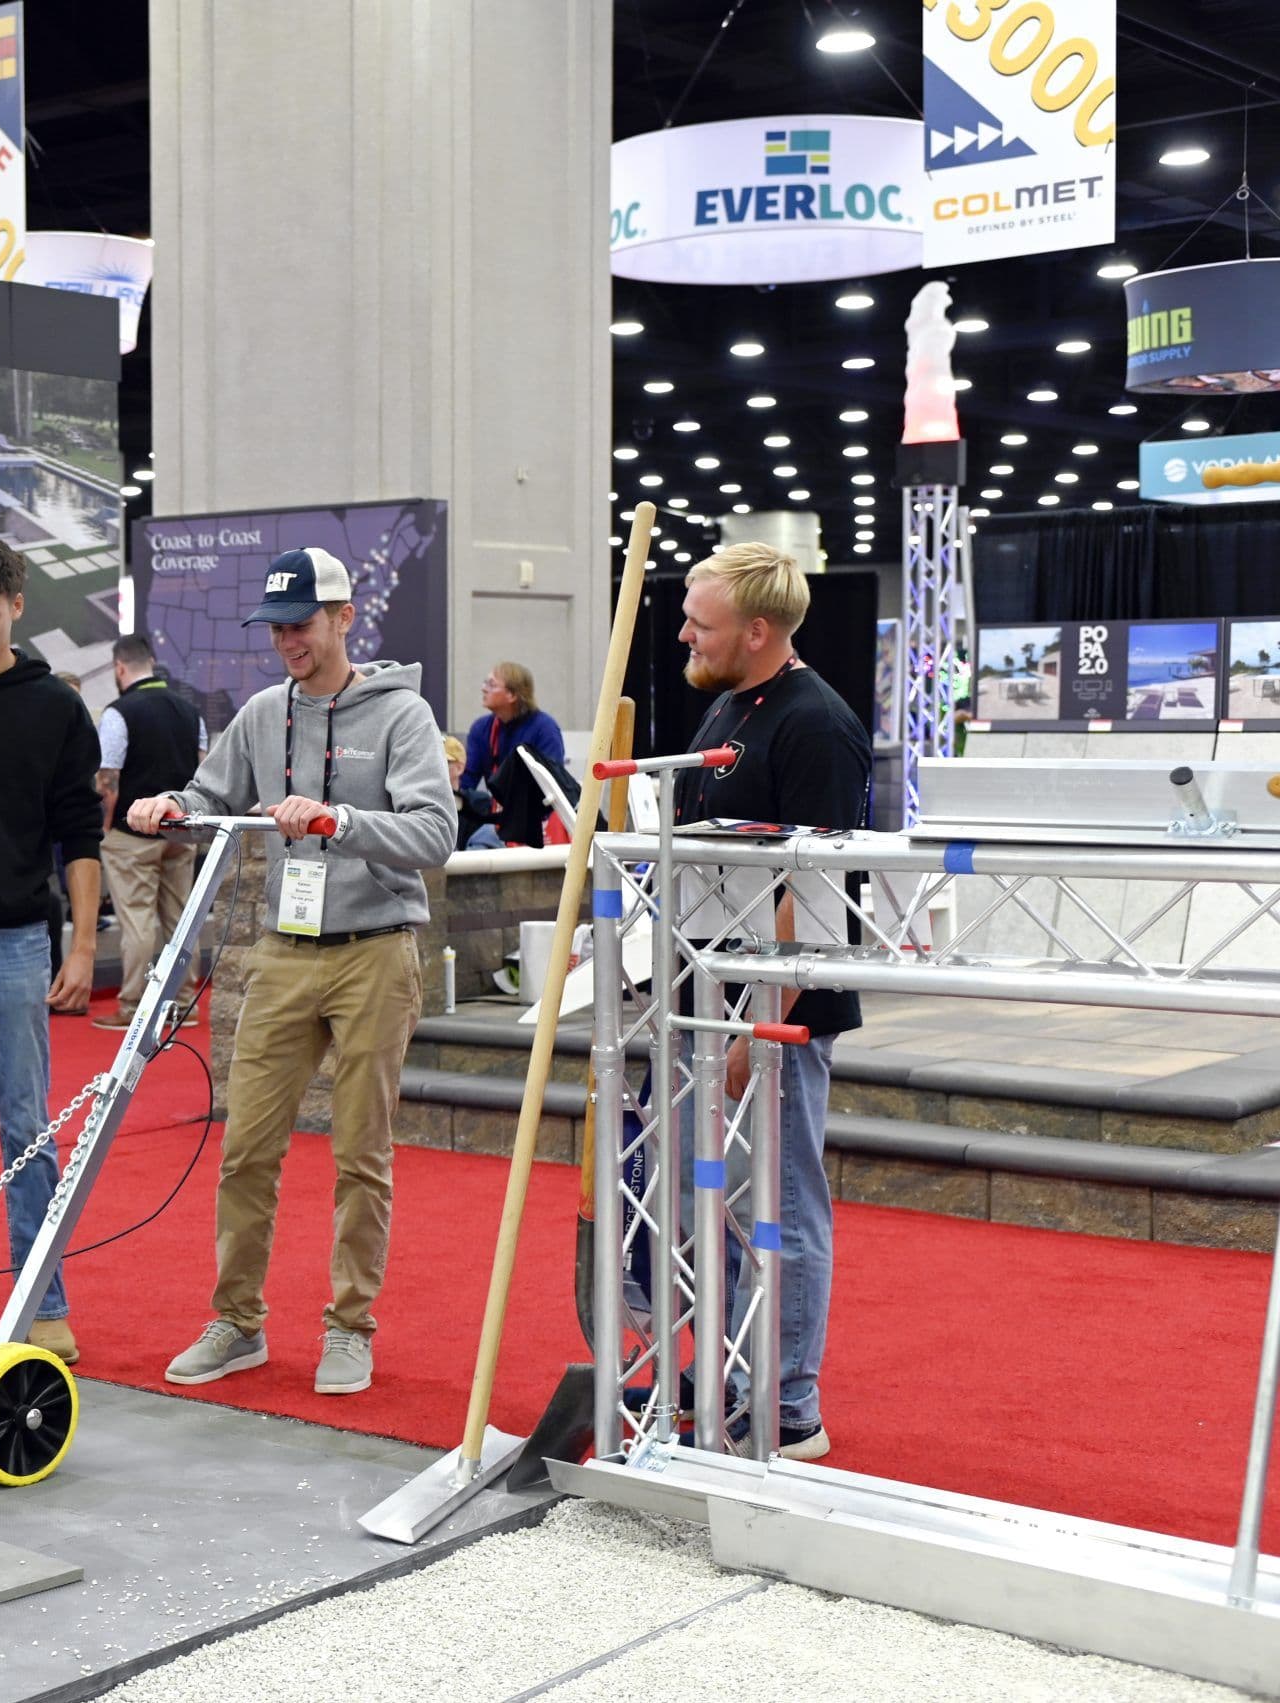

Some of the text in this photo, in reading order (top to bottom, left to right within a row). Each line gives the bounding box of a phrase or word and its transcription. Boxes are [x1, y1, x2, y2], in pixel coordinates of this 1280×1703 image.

[923, 0, 1115, 147] 3000
[694, 183, 903, 226] EVERLOC
[933, 176, 1103, 220] COLMET
[967, 213, 1073, 235] DEFINED BY STEEL
[1148, 345, 1192, 363] SUPPLY
[151, 553, 220, 573] Coverage
[265, 572, 298, 593] CAT
[1079, 626, 1108, 642] PO
[1078, 642, 1106, 658] PA
[1077, 658, 1109, 675] 2.0
[126, 1017, 144, 1051] probst
